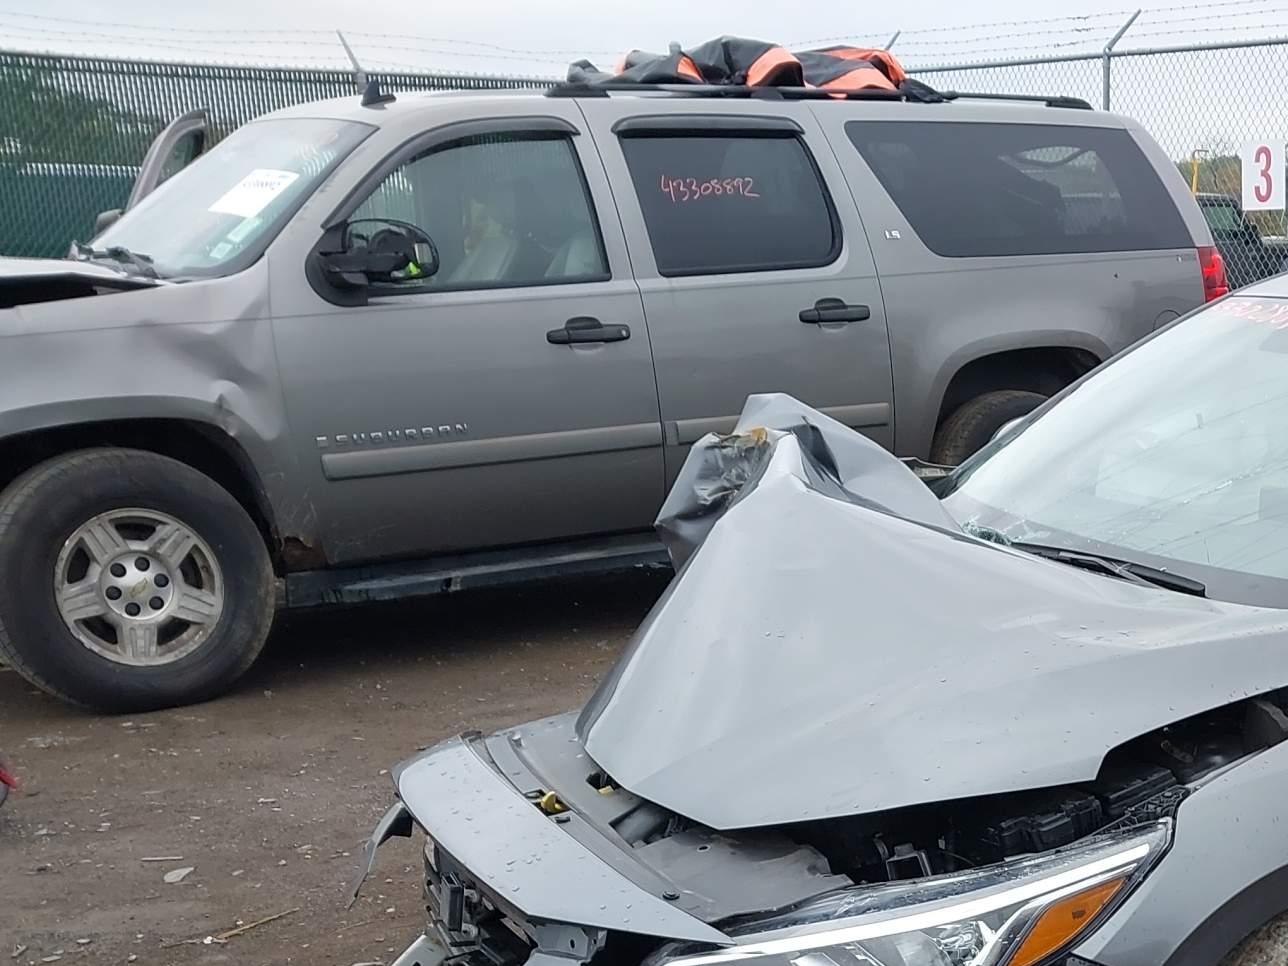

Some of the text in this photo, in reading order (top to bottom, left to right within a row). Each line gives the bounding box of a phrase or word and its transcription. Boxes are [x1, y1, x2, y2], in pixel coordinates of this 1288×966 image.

[660, 174, 761, 202] 43308892
[1254, 145, 1273, 203] 3
[335, 422, 468, 446] SUBURBAN
